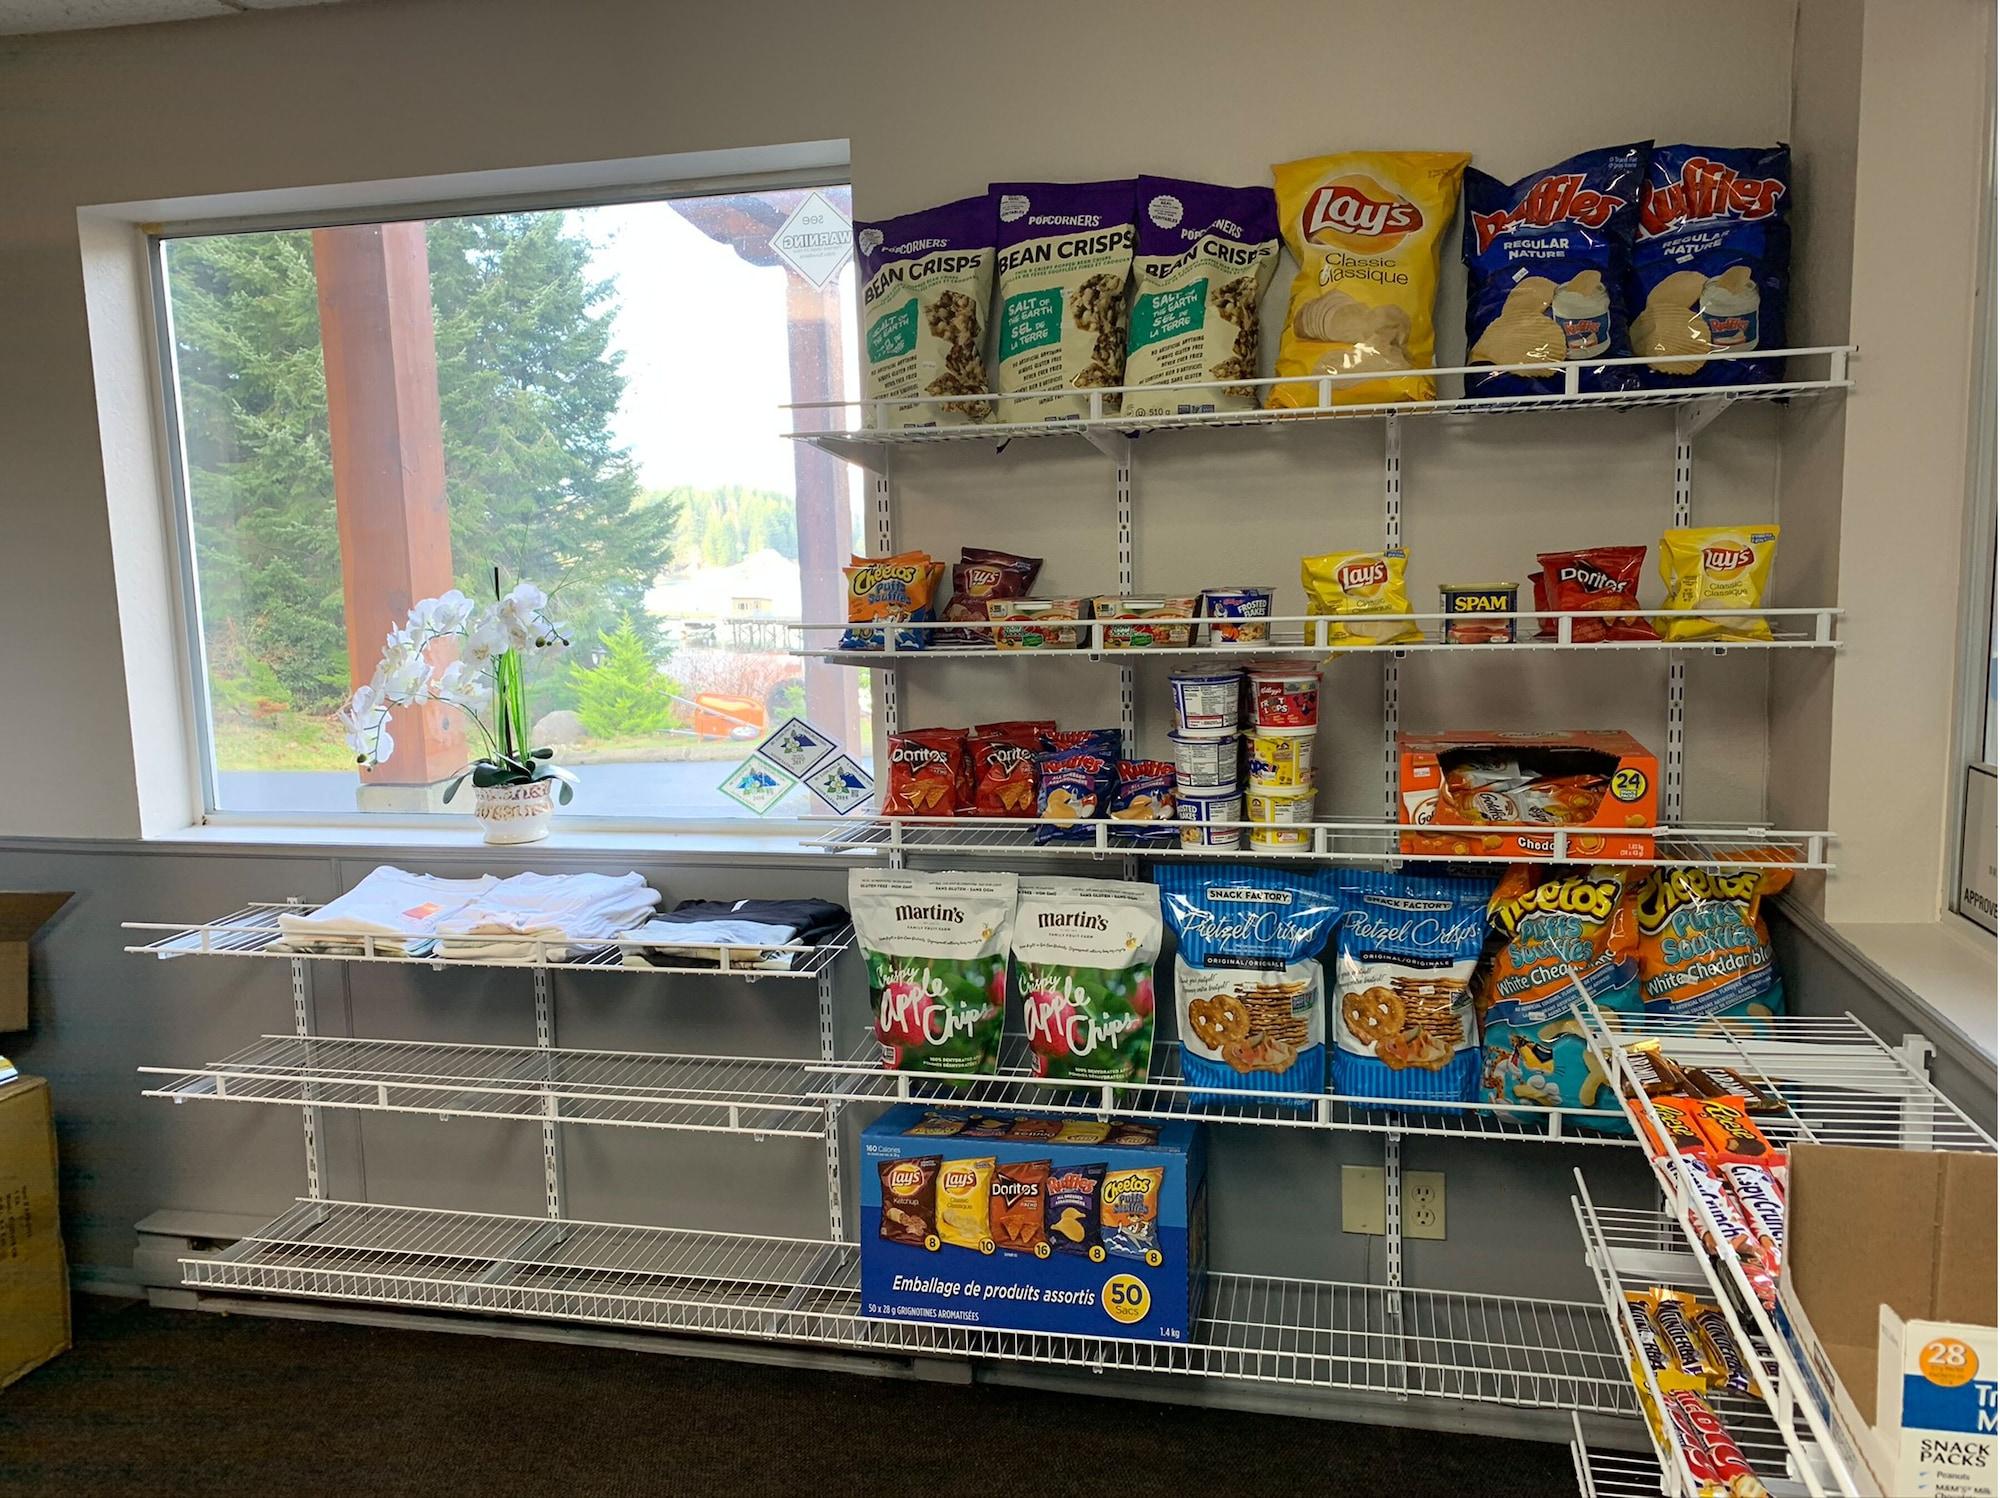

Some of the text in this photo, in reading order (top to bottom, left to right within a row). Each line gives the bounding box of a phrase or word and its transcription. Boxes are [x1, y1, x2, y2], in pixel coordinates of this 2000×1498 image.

[1636, 156, 1786, 243] Ruffles
[1310, 187, 1414, 236] Lay's
[1028, 215, 1100, 227] POPCORNERS
[1503, 238, 1569, 250] REGULAR
[1662, 230, 1730, 249] REGULAR
[1663, 239, 1723, 256] NATURE
[1000, 243, 1051, 276] BEAN
[1057, 230, 1132, 259] CRISPS
[1146, 246, 1198, 279] BEAN
[1203, 240, 1270, 266] CRISPS
[1325, 252, 1397, 268] Classic
[1508, 250, 1566, 260] NATURE
[865, 266, 903, 305] BEAN
[909, 255, 981, 280] CRISPS
[1318, 266, 1409, 287] Classique
[1008, 297, 1036, 316] SALT
[1152, 291, 1180, 308] SALT
[1168, 294, 1198, 313] EARTH
[1021, 306, 1053, 320] EARTH
[1153, 312, 1175, 327] SEL
[1011, 320, 1046, 339] SEL DE
[1150, 316, 1191, 338] LA TERRE
[1020, 328, 1048, 344] TERRE
[1192, 343, 1204, 351] FREE
[1149, 408, 1163, 417] 510
[1705, 548, 1753, 571] Lay's
[854, 563, 917, 595] Cheetos
[1341, 560, 1387, 589] Lay's
[1560, 567, 1628, 594] Doritos
[1703, 588, 1749, 598] Classique
[1709, 580, 1743, 590] Classic
[1237, 600, 1267, 614] FROSTED
[1244, 607, 1266, 618] FLAKES
[1455, 596, 1508, 612] SPAM
[1260, 687, 1282, 696] Kellogg's
[892, 748, 948, 764] Doritos
[1617, 773, 1639, 788] 24
[1210, 889, 1289, 902] SNACK FACTORY
[1366, 896, 1450, 910] SNACK FACTORY
[1637, 867, 1761, 930] Cheetos
[896, 904, 965, 924] martin's
[1038, 911, 1109, 931] martin's
[1672, 902, 1740, 937] Puffs
[1181, 911, 1317, 956] Pretzel Crisps
[1344, 911, 1477, 950] Pretzel Crisps
[1520, 916, 1584, 944] Puffs
[1662, 924, 1759, 965] Soufflés
[1363, 954, 1450, 967] ORIGINAL/ORIGINALE
[1509, 938, 1593, 969] Soufflés
[1207, 957, 1284, 969] ORIGINAL/ORIGINALE
[877, 962, 919, 988] Crispy
[1019, 971, 1061, 996] Crispy
[1647, 955, 1750, 996] White Cheddar
[1497, 977, 1529, 996] White
[881, 967, 949, 1034] Apple
[1024, 976, 1090, 1042] Apple
[923, 1000, 993, 1046] Chips
[1066, 1012, 1140, 1056] Chips
[866, 1144, 877, 1154] 160
[891, 1170, 921, 1187] Lay's
[945, 1170, 974, 1188] Lay's
[1047, 1173, 1097, 1195] Ruffles
[992, 1183, 1039, 1196] Doritos
[1103, 1174, 1151, 1204] Cheetos
[893, 1197, 920, 1206] Ketchup
[929, 1238, 936, 1248] 8
[981, 1241, 993, 1251] 10
[1036, 1245, 1047, 1255] 16
[1094, 1249, 1101, 1258] 8
[1151, 1253, 1157, 1263] 8
[892, 1274, 1096, 1308] Emballage de produits assortis
[1111, 1283, 1143, 1305] 50
[868, 1304, 877, 1313] 50
[883, 1305, 891, 1314] 28
[891, 1308, 897, 1316] g
[897, 1305, 937, 1319] GRIGNOTINES
[938, 1308, 979, 1321] AROMATISÉES
[1115, 1304, 1139, 1317] Sacs
[1160, 1327, 1180, 1340] 1.4 kg
[1928, 1343, 1967, 1367] 28
[1921, 1439, 1990, 1456] SNACK
[1920, 1451, 1987, 1468] PACKS
[1937, 1470, 1970, 1481] Peanuts
